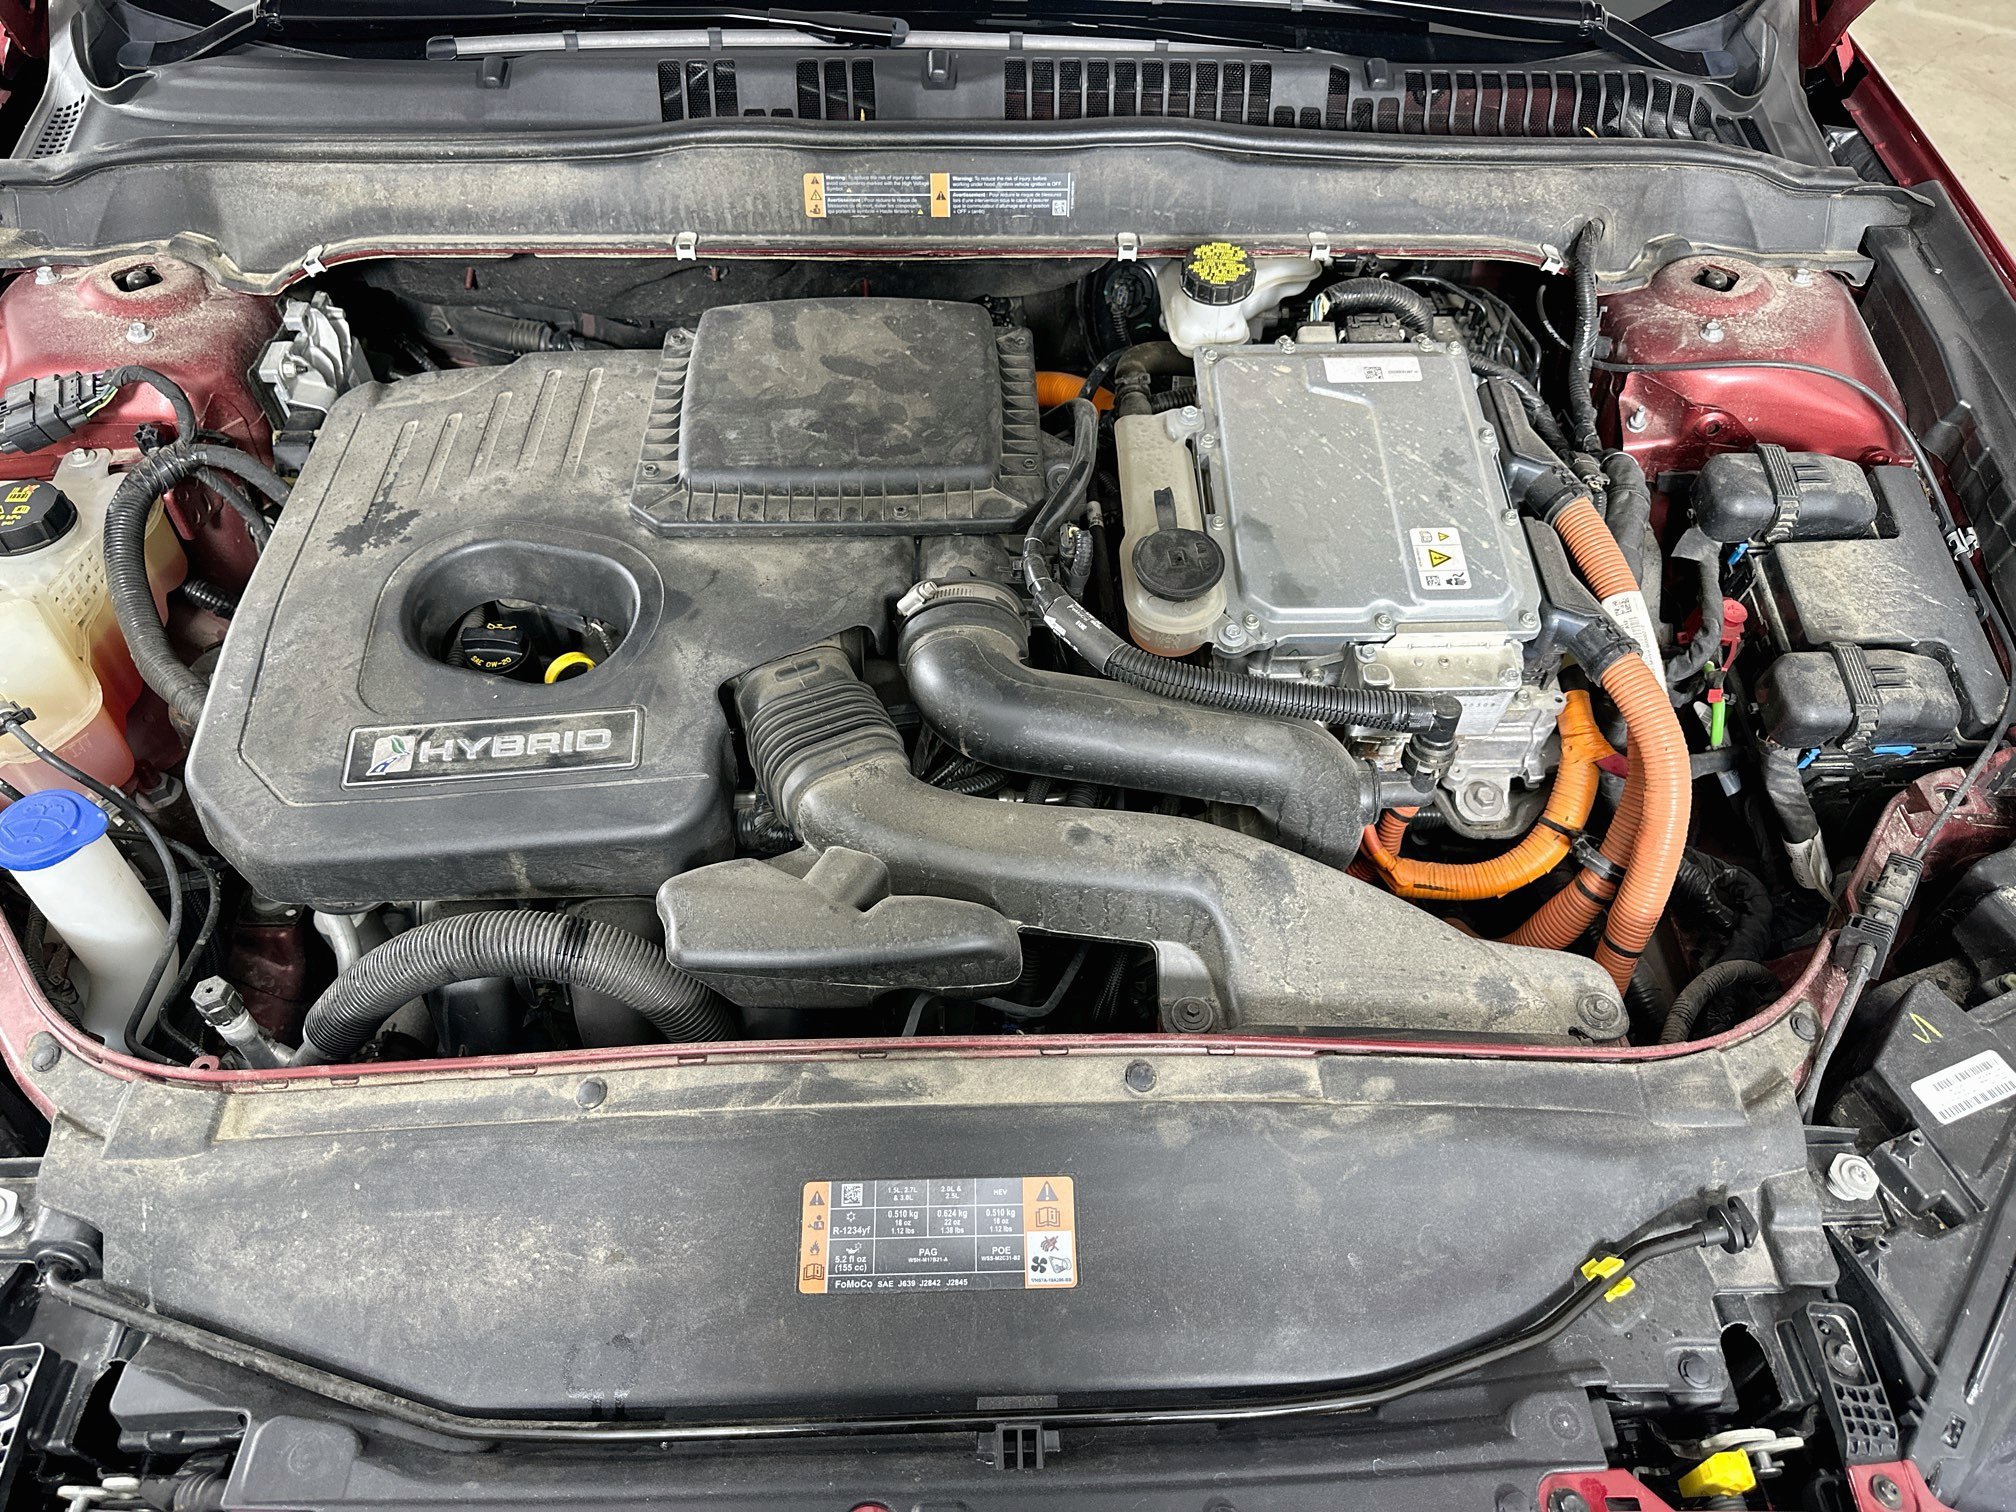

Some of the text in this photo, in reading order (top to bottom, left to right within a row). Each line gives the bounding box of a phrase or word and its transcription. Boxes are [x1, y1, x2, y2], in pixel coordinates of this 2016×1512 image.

[470, 655, 484, 666] SAE
[418, 728, 612, 763] HYBRID
[888, 1210, 918, 1219] 0.510 kg
[937, 1209, 968, 1218] 0.624 kg
[1006, 1209, 1015, 1218] kg
[832, 1225, 871, 1236] R-1234yf
[918, 1248, 938, 1256] PAG
[991, 1246, 1011, 1255] POE
[834, 1263, 867, 1273] (155 cc)
[835, 1280, 873, 1289] FoMoCo
